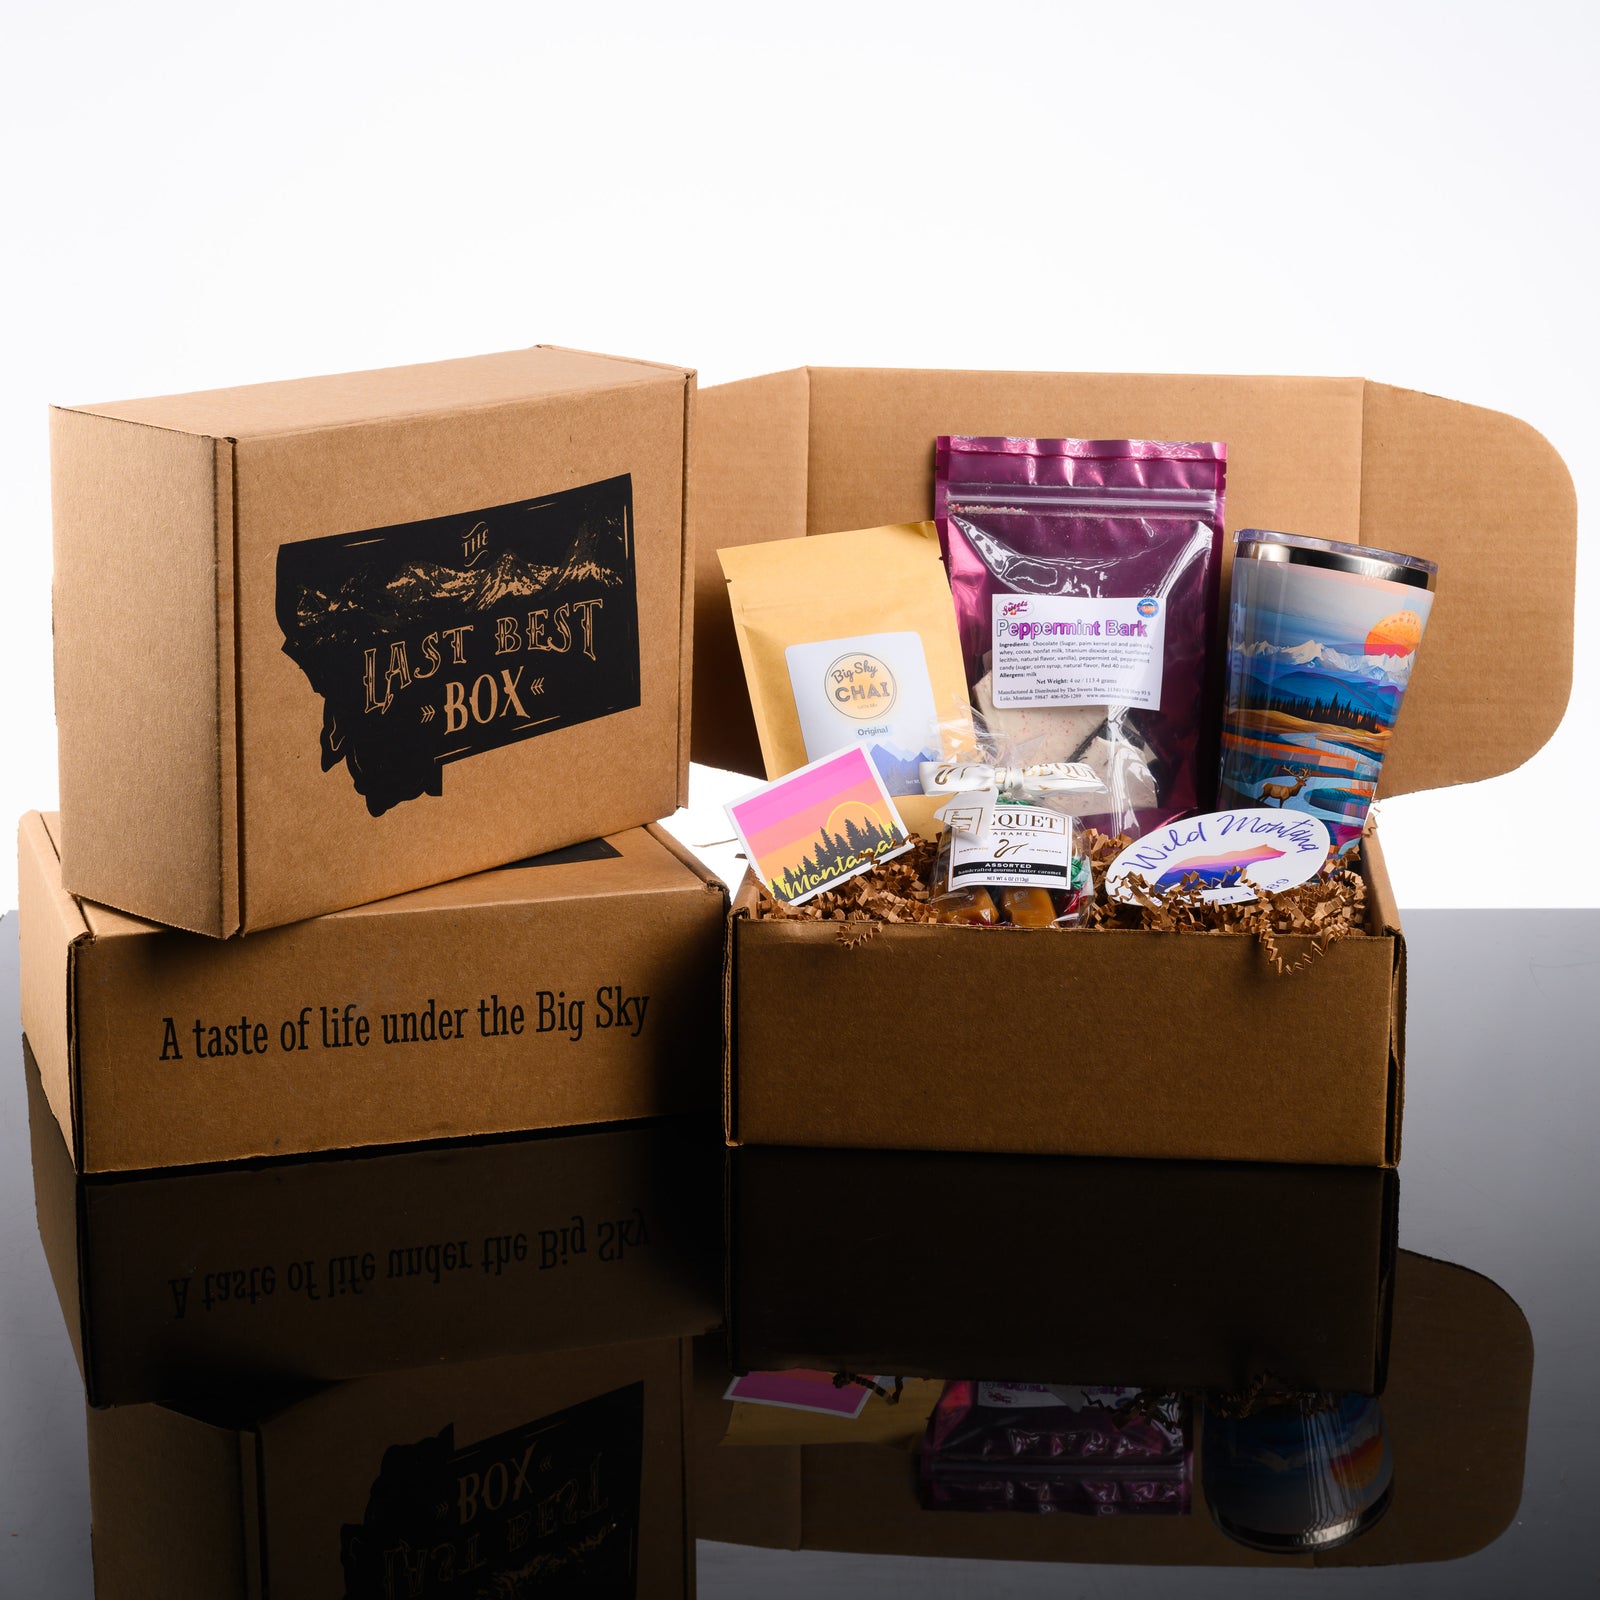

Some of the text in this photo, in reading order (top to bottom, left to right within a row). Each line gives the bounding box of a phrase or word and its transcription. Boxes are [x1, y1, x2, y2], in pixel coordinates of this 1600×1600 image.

[461, 529, 489, 557] THE
[996, 619, 1148, 640] Peppermint Bark
[363, 599, 604, 714] LAST BEST
[831, 660, 879, 684] Big Sky
[443, 666, 531, 736] BOX
[835, 682, 890, 702] CHAI
[857, 725, 889, 737] Original
[1122, 814, 1320, 871] Wild Montana
[784, 839, 895, 900] Montana
[958, 867, 992, 875] handcrafted
[159, 985, 650, 1061] A taste of life under the Big Sky
